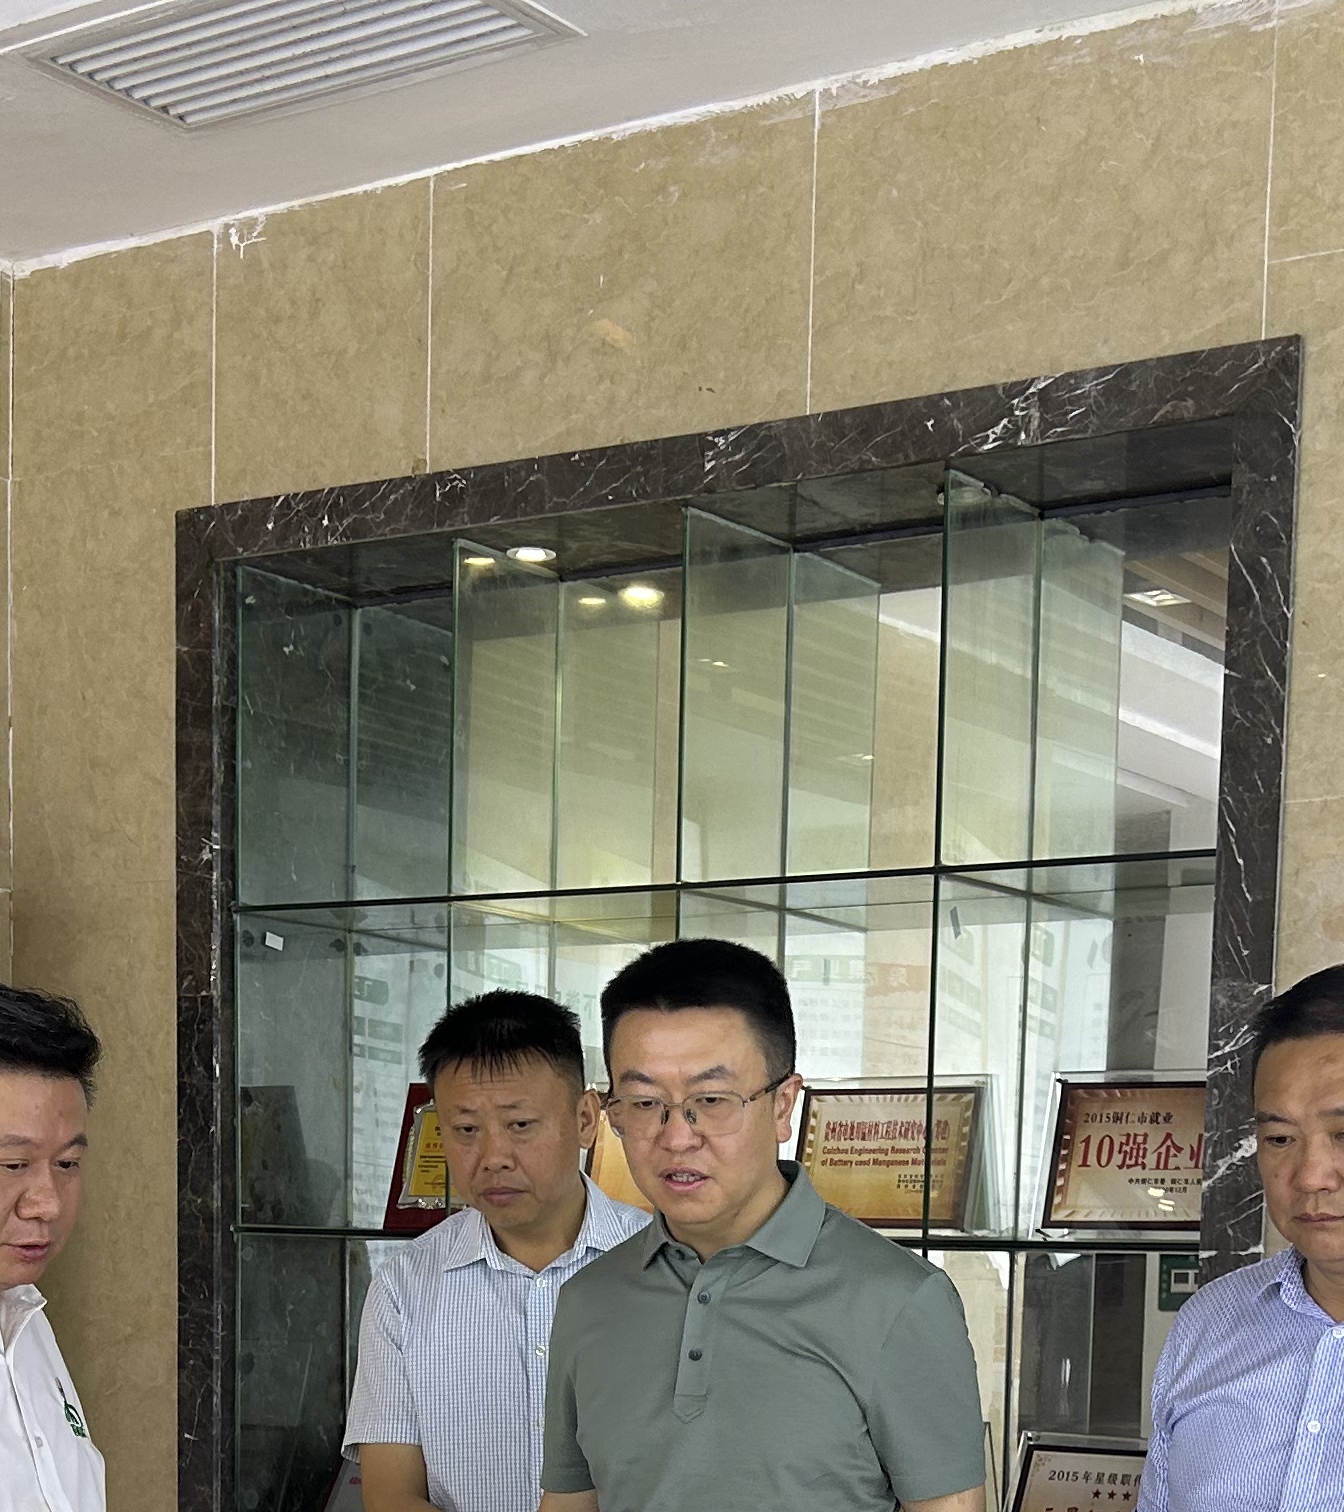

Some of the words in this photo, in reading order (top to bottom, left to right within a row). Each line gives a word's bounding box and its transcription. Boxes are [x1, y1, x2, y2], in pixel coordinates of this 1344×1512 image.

[1083, 1111, 1175, 1126] 2015铜仁市就业
[850, 1145, 890, 1157] Engineering
